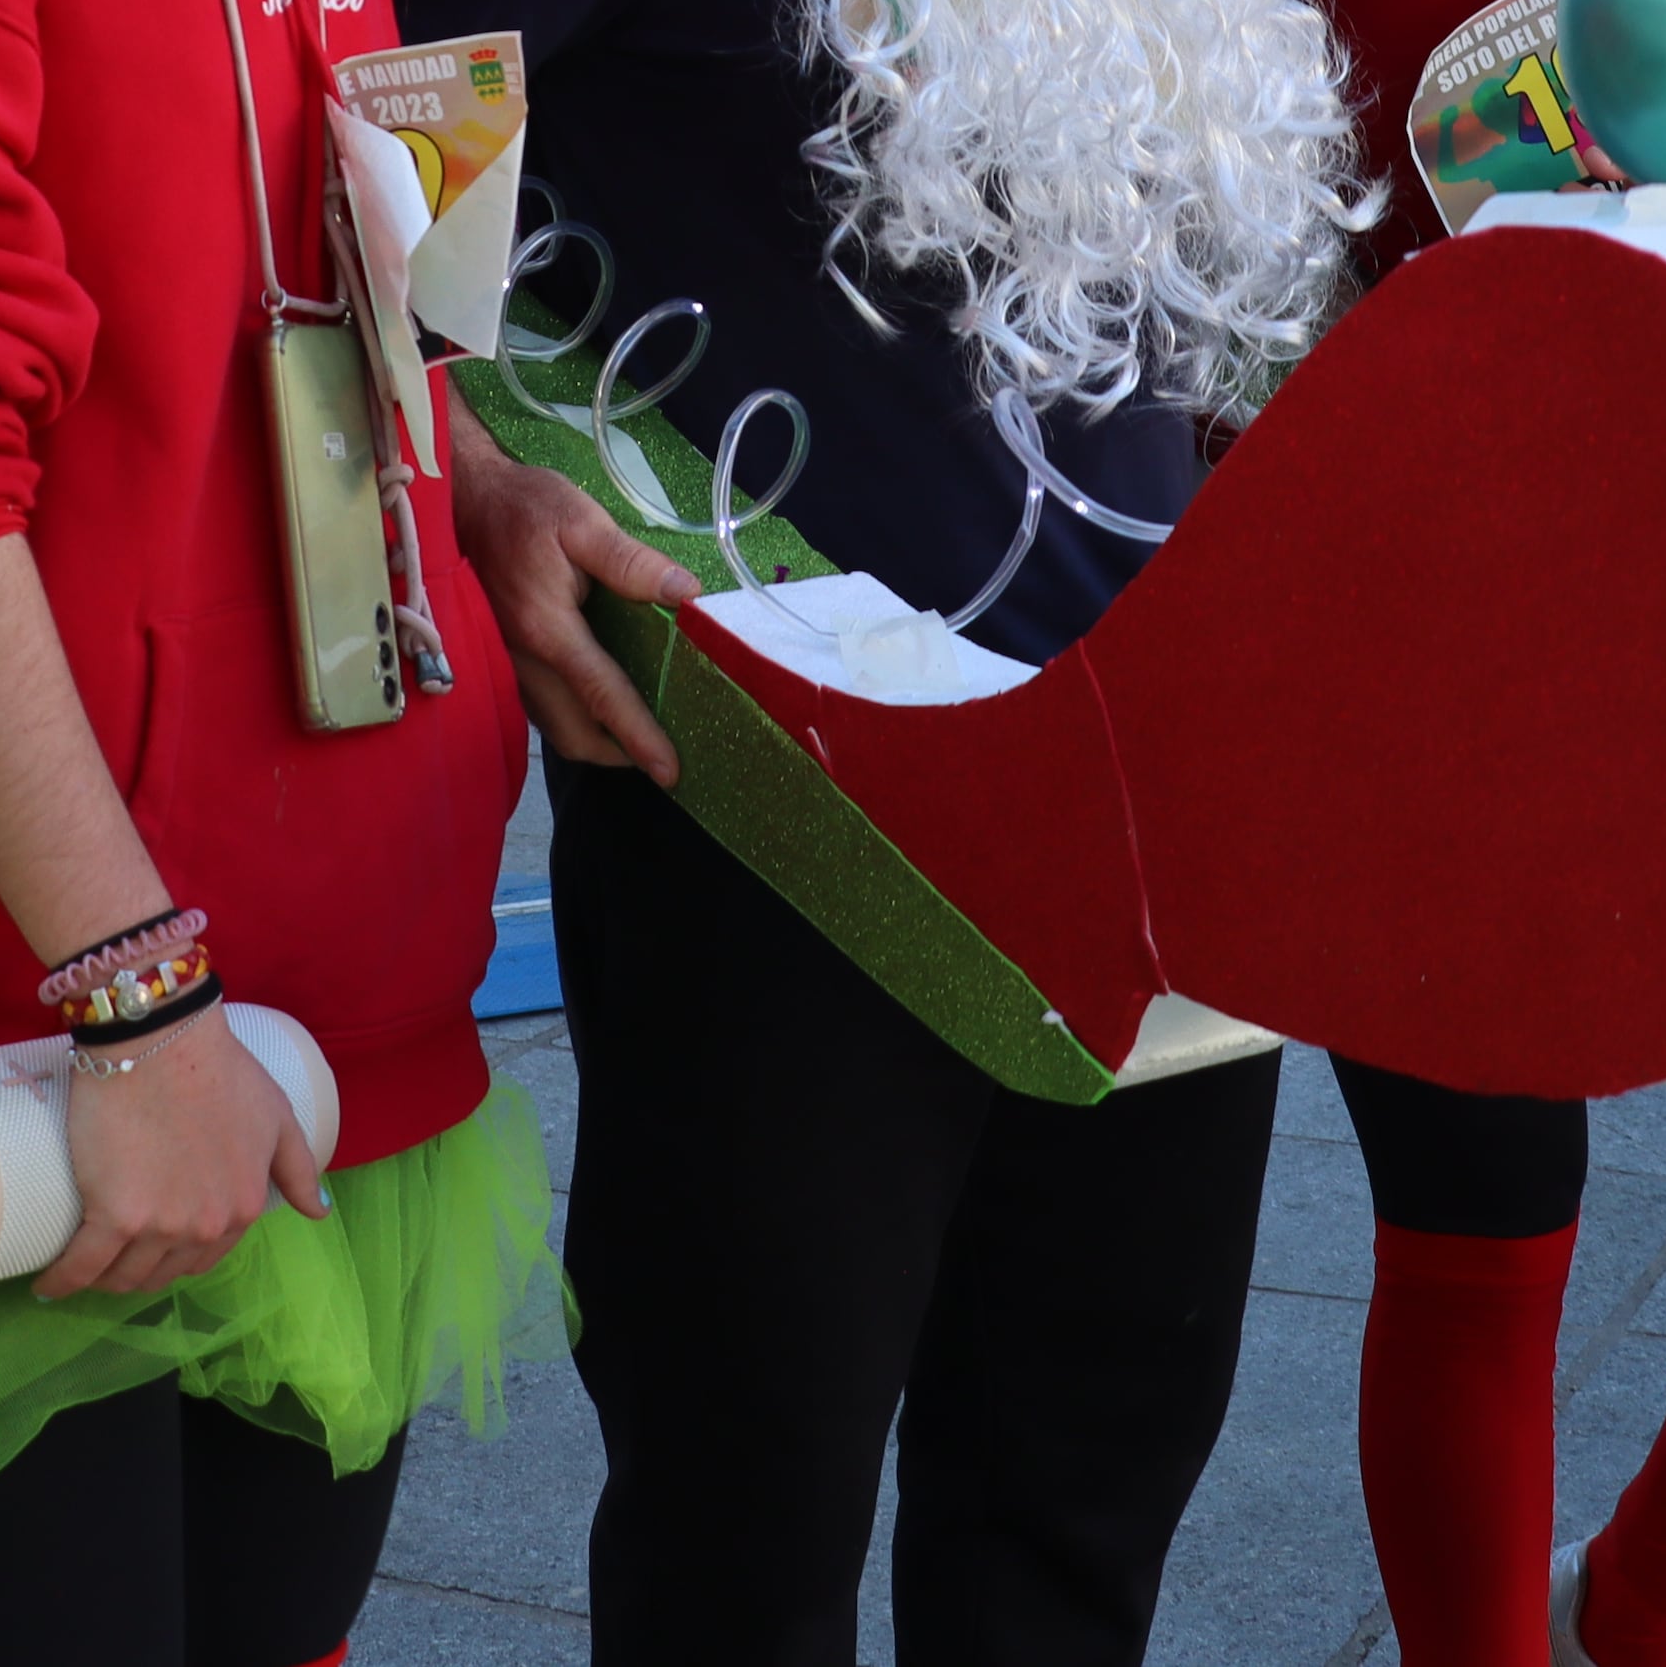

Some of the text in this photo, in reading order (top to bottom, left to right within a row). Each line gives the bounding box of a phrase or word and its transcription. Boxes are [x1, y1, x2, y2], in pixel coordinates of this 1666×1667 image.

[355, 53, 457, 91] NAVIDAD
[1436, 45, 1496, 94] SOTO
[1495, 23, 1541, 61] DEL
[372, 92, 445, 126] 2023
